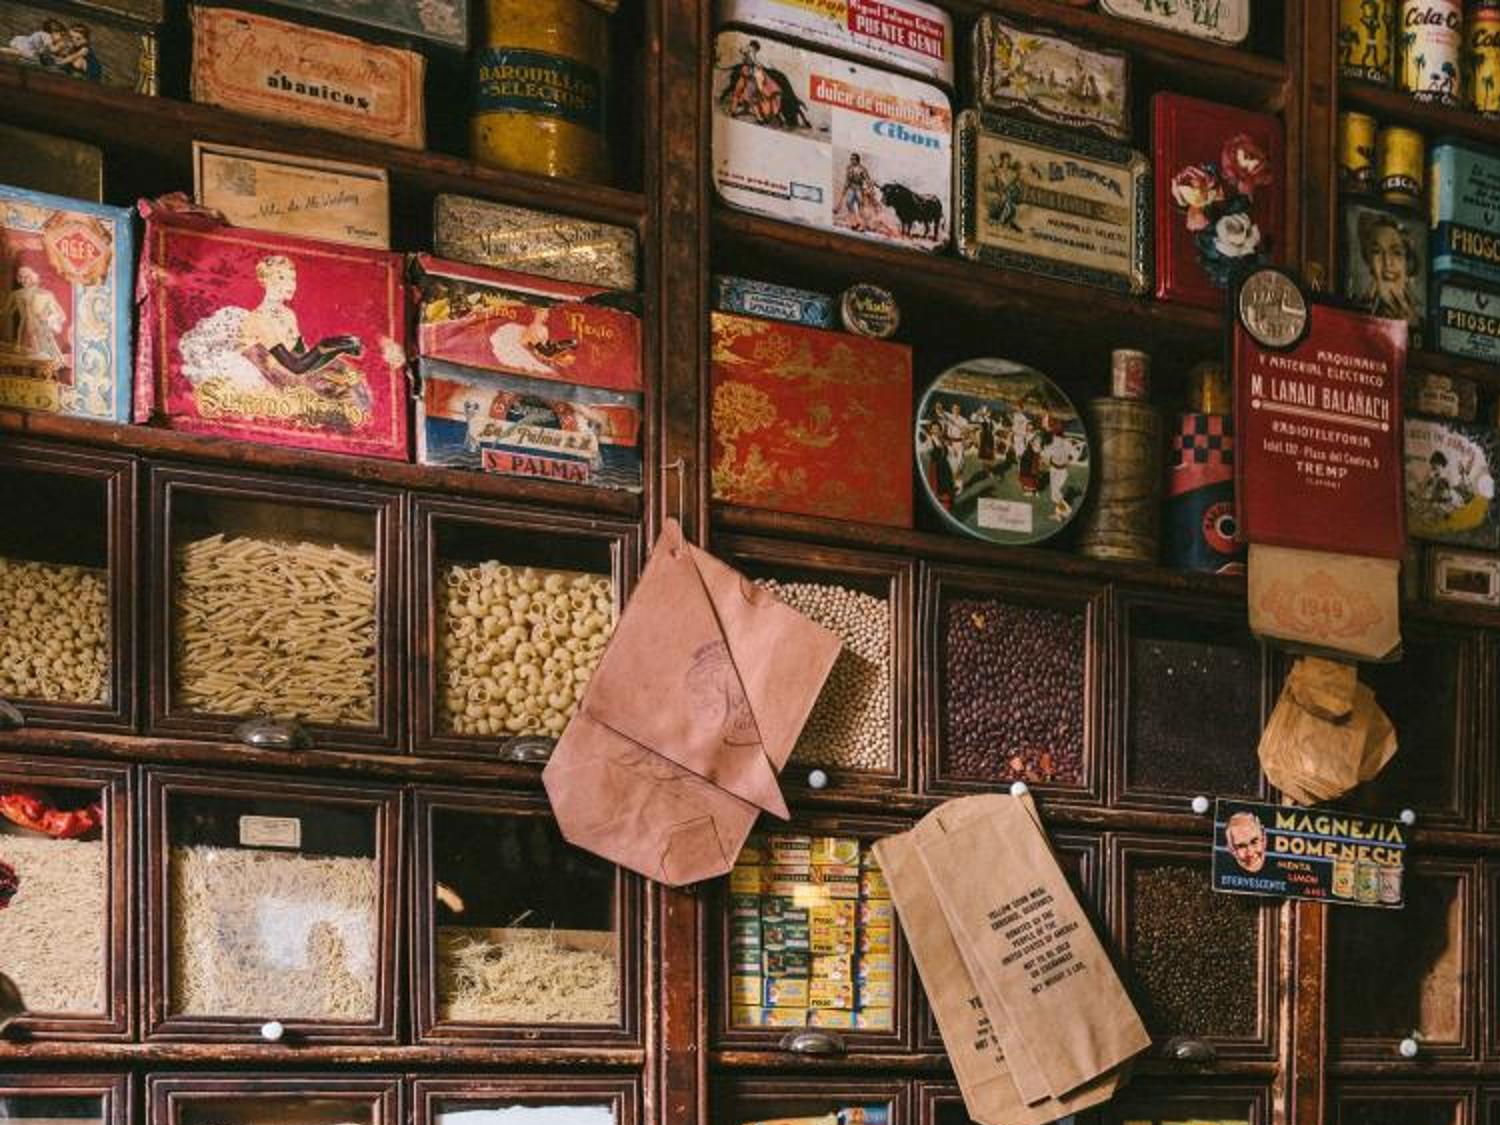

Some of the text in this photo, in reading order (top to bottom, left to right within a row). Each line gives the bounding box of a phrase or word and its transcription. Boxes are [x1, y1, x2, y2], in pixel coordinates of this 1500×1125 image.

[857, 15, 905, 43] PUENTE
[909, 33, 943, 58] GENIL
[873, 121, 941, 149] Cibon
[1269, 356, 1322, 376] MATERIAL
[1327, 368, 1384, 388] ELECTRICO
[1251, 373, 1267, 399] M.
[1271, 378, 1316, 407] LANAU
[1271, 420, 1371, 449] RADIOTELEFONIA
[511, 456, 586, 481] PALMA
[1296, 461, 1348, 478] TREMP
[1275, 811, 1403, 843] MAGNESIA
[1274, 835, 1402, 866] DOMENECH
[1220, 874, 1288, 892] EFERVESCENTE
[1053, 920, 1080, 939] AMERICA
